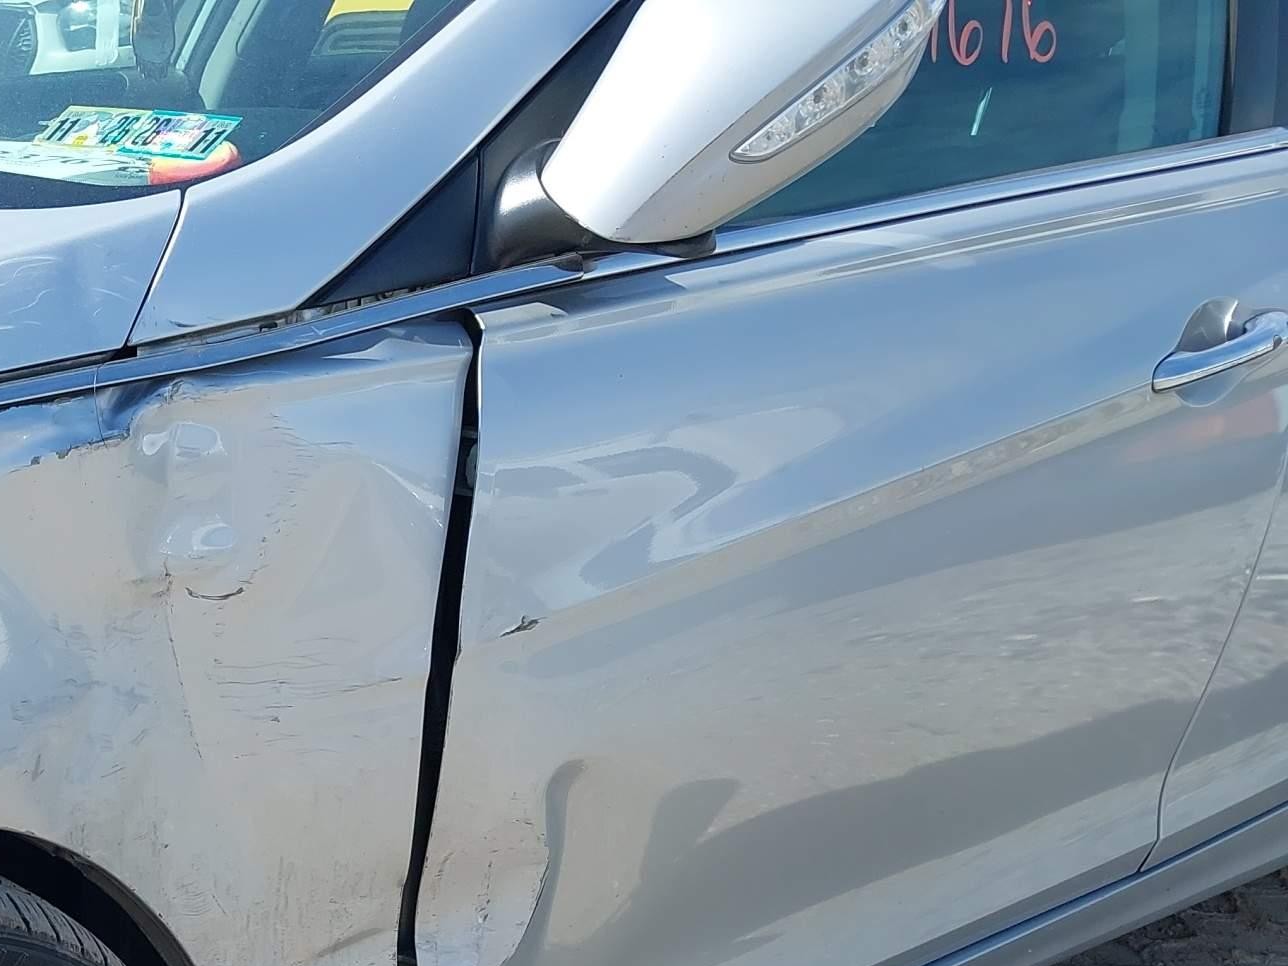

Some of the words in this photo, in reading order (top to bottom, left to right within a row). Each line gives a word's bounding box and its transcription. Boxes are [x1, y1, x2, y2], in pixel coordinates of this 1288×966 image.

[46, 117, 81, 141] 11
[99, 116, 141, 144] 26
[189, 127, 226, 154] 11
